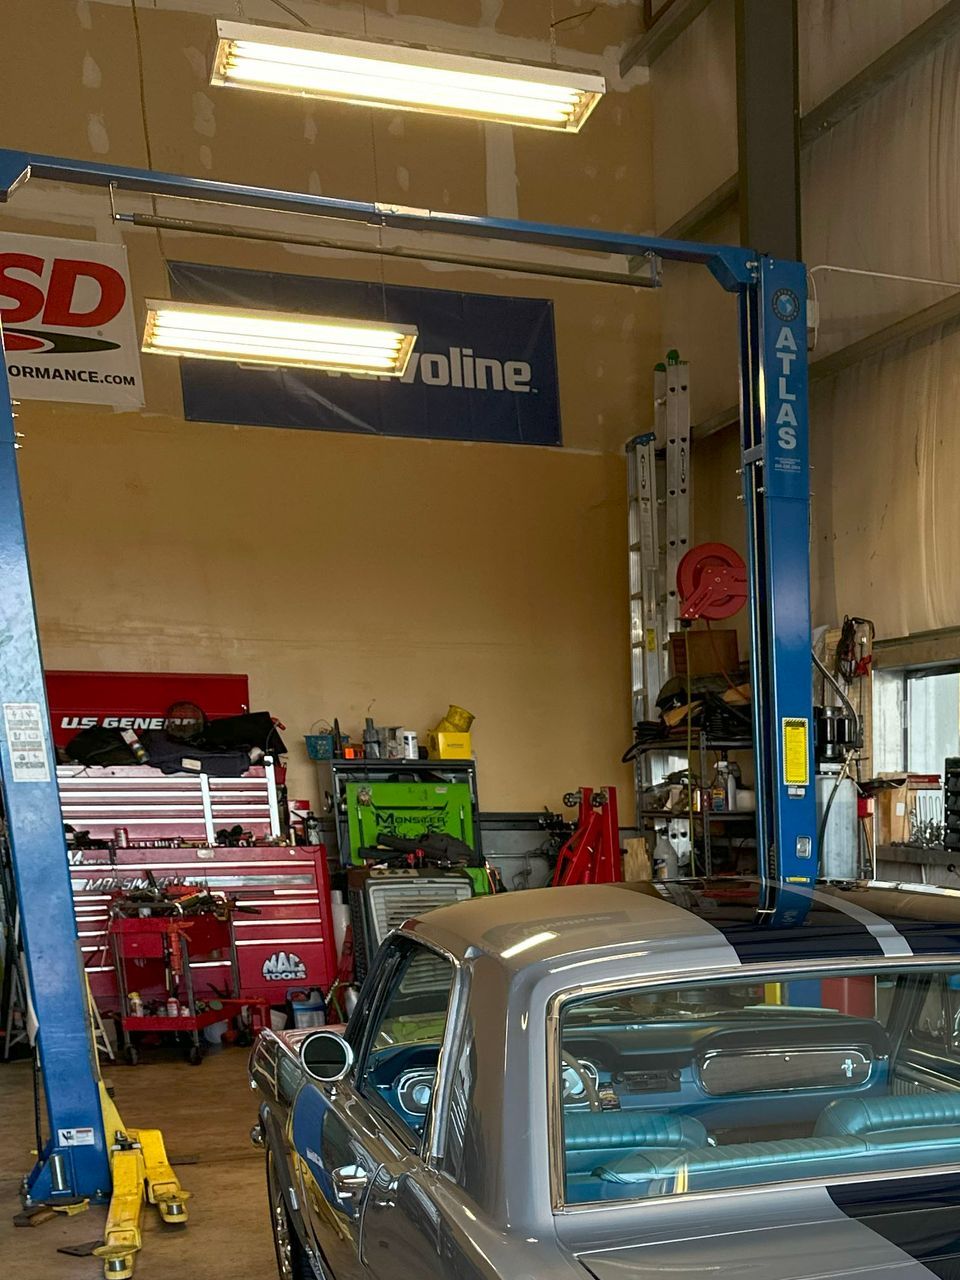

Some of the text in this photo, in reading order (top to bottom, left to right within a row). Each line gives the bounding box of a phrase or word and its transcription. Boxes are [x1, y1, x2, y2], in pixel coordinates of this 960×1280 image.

[775, 326, 798, 450] ATLAS
[262, 951, 306, 974] MAC
[263, 971, 307, 981] TOOLS
